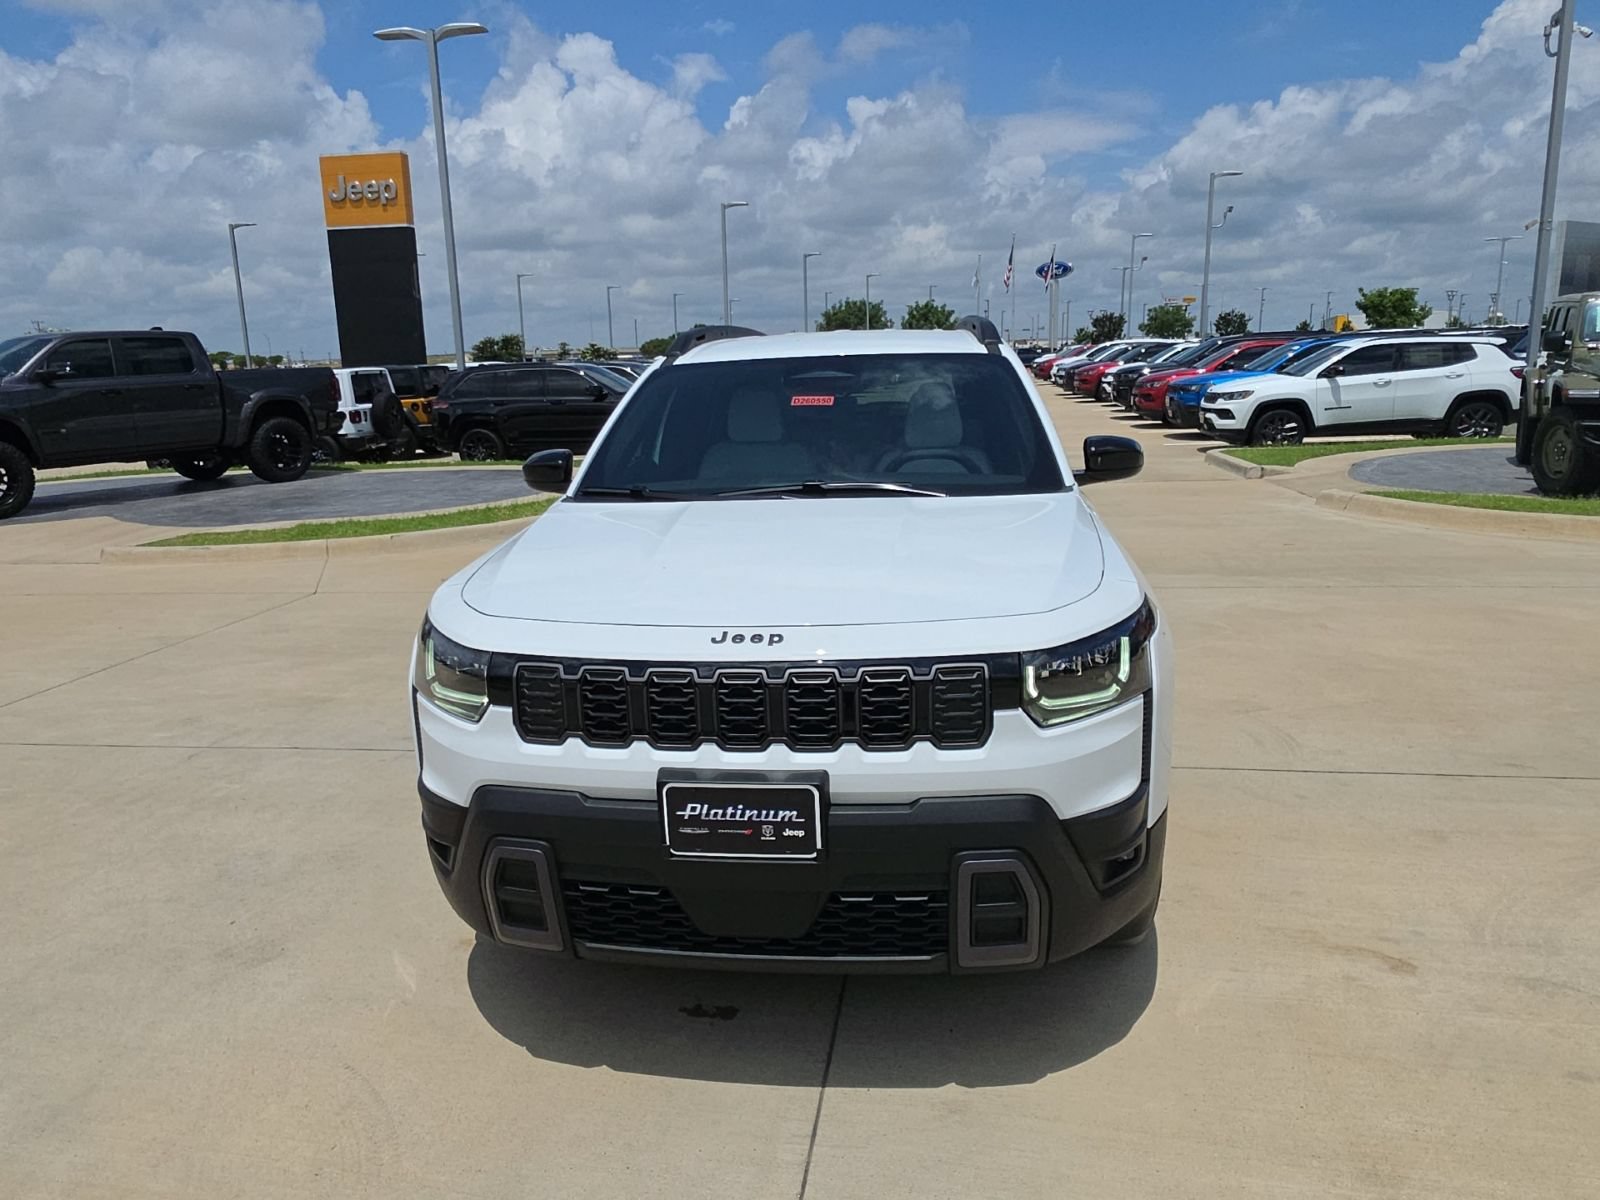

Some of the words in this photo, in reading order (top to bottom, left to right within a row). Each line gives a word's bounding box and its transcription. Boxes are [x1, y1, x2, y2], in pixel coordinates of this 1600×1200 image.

[328, 175, 397, 205] Jeep
[710, 631, 784, 647] Jeep
[675, 803, 806, 822] Platinum
[782, 828, 805, 838] Jeep
